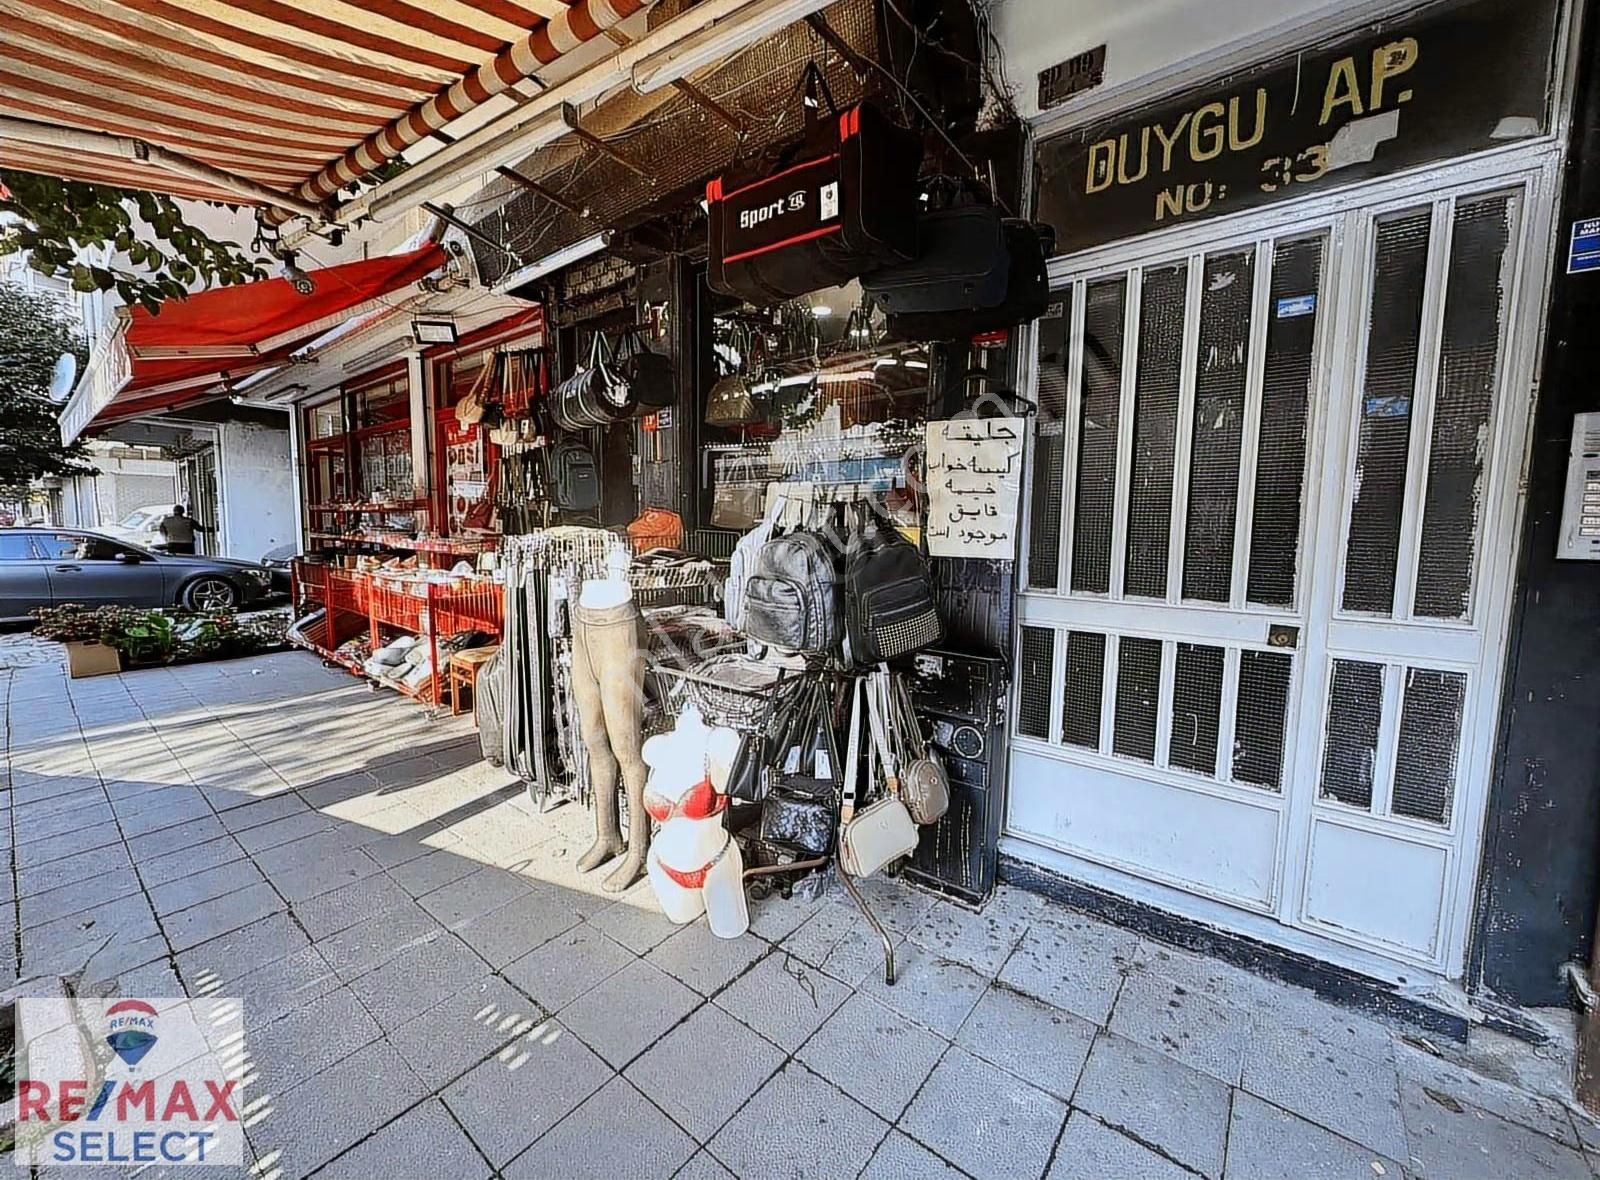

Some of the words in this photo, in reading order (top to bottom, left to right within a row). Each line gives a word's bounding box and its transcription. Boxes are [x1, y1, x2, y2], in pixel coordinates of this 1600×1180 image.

[1086, 88, 1267, 194] DUYGU
[1319, 37, 1418, 126] AP.
[740, 199, 785, 229] Sport
[1155, 180, 1227, 221] NO:
